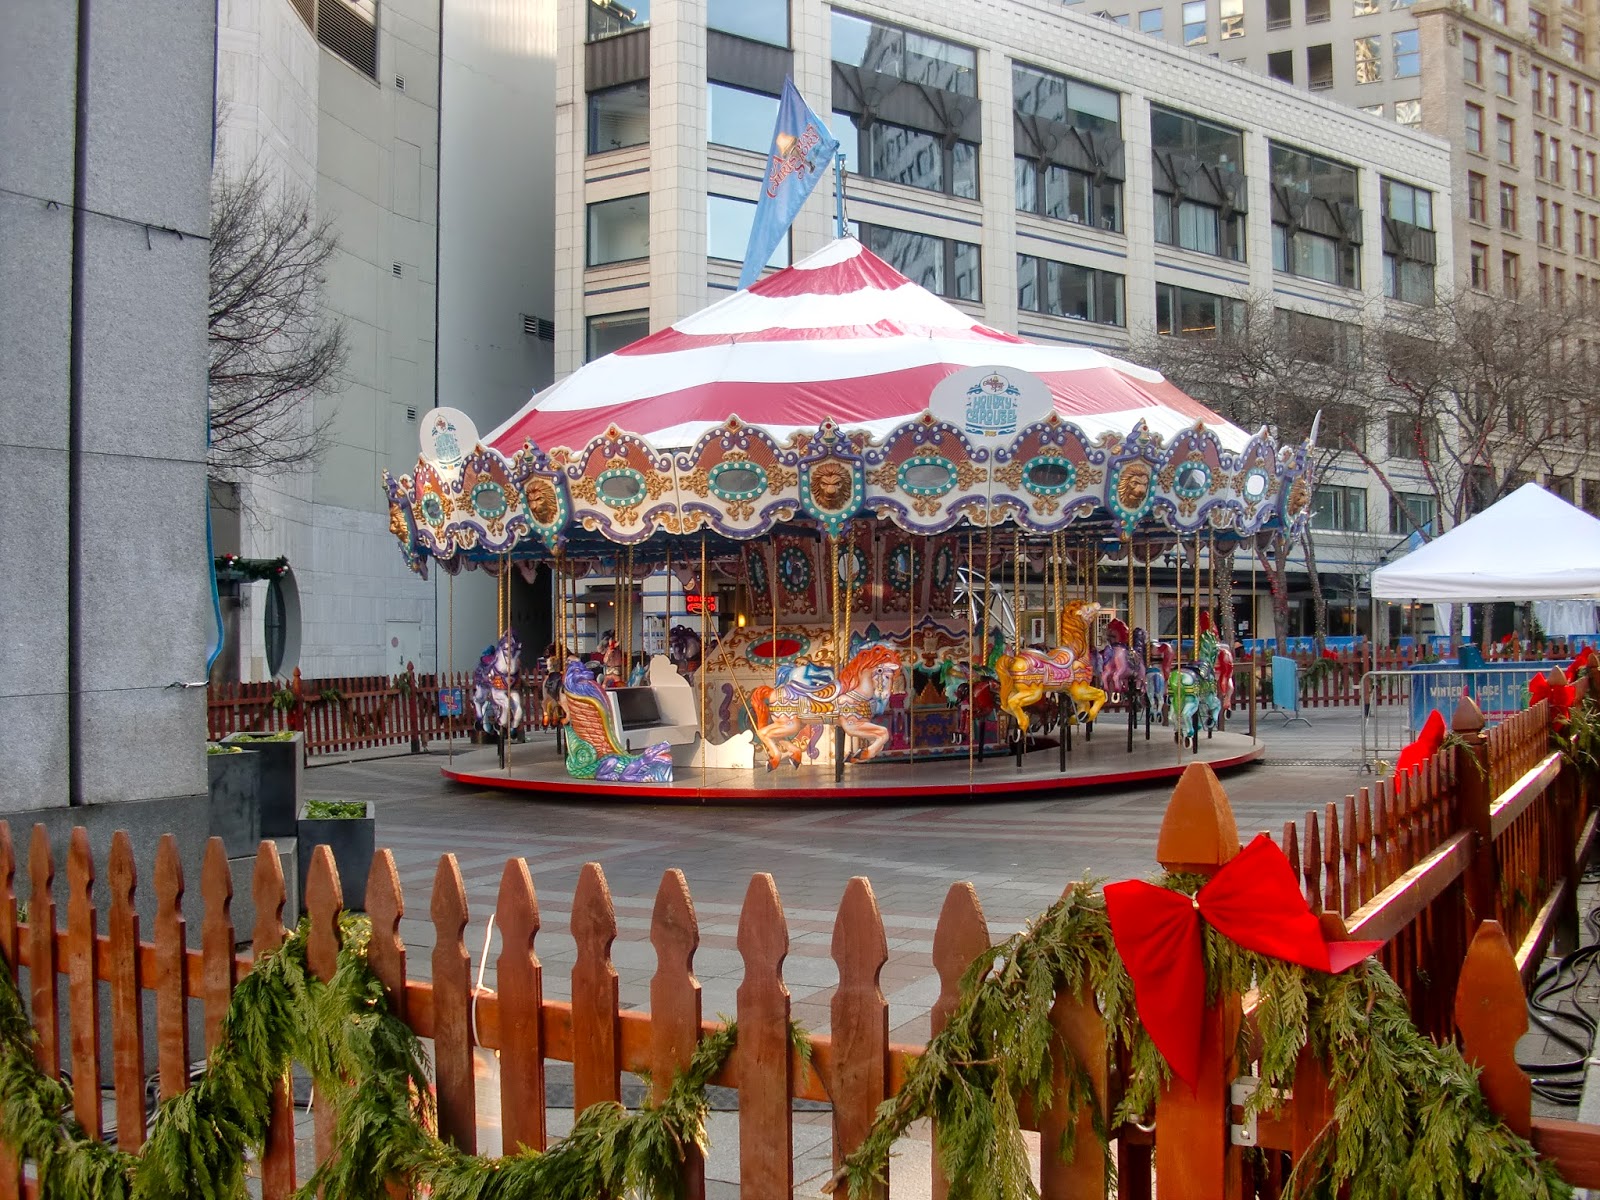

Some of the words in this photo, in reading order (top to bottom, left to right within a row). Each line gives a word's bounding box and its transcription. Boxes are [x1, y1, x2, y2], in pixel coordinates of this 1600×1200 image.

[766, 123, 815, 198] CHRISMAS
[966, 408, 1017, 425] CAROUSEL
[1430, 687, 1462, 697] WINTER
